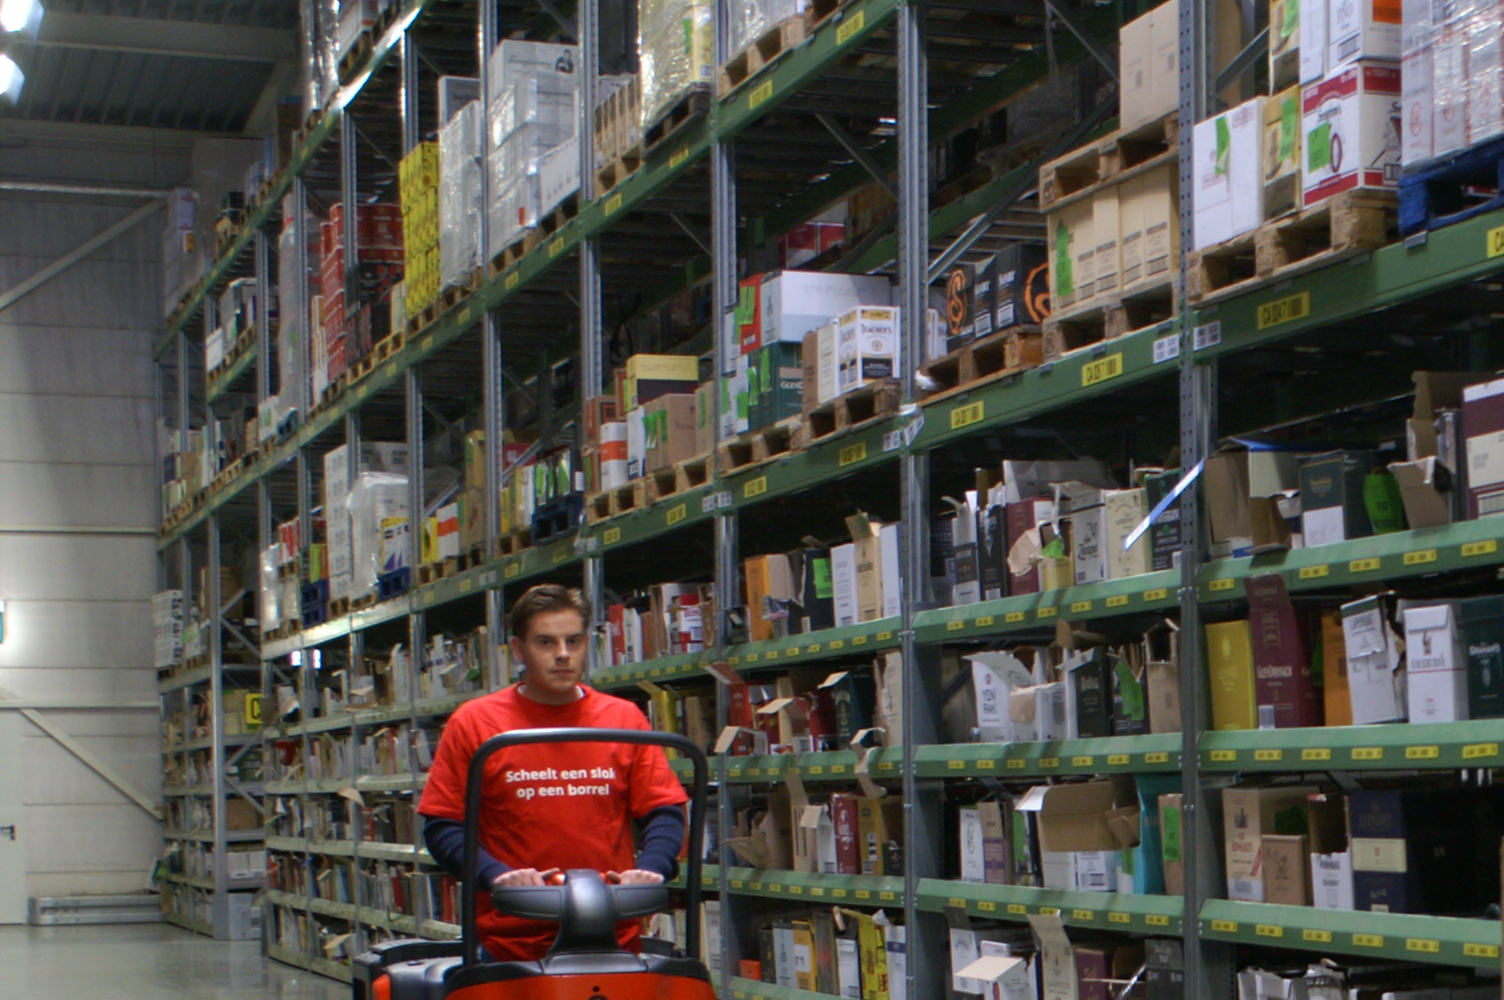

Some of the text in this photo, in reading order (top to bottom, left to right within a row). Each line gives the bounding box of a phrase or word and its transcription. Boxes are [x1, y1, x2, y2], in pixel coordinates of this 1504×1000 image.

[561, 769, 588, 780] een
[517, 783, 611, 800] op een borrel
